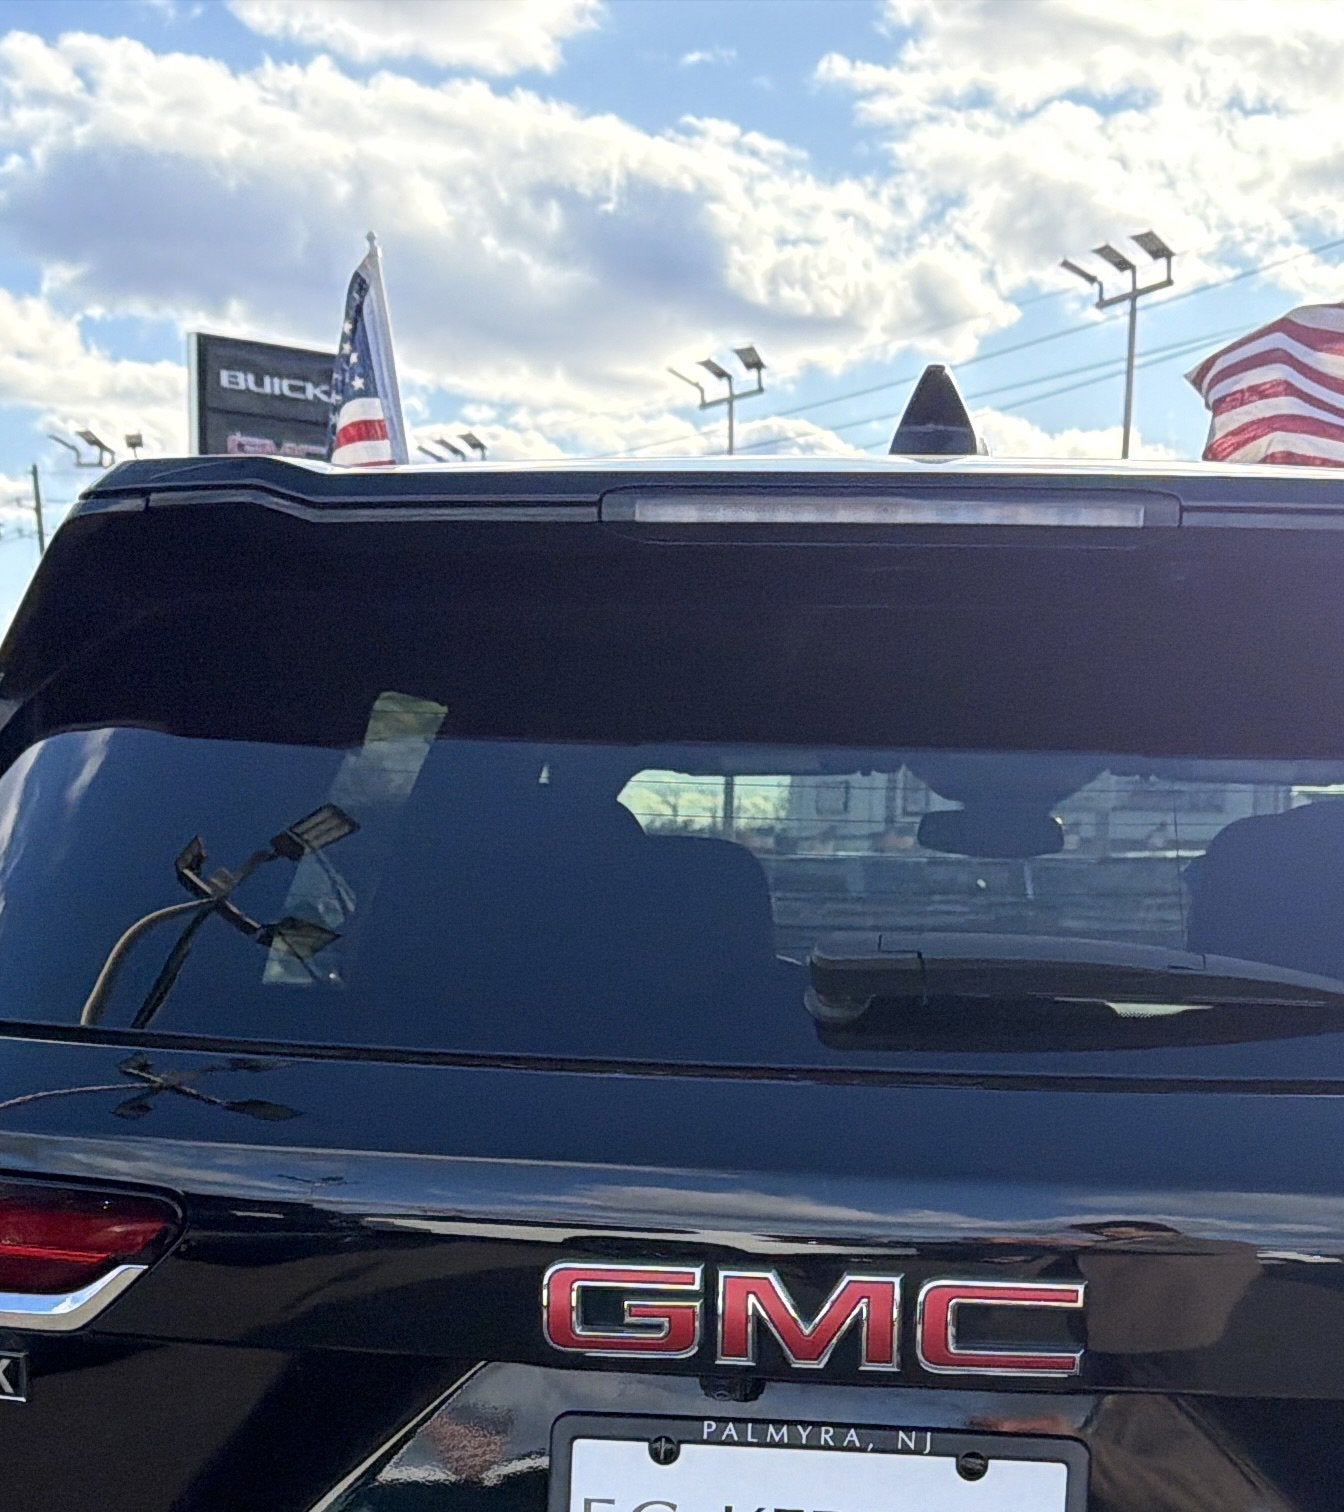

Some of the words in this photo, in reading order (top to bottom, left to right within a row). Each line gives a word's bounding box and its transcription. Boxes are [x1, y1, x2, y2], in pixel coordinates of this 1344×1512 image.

[220, 369, 335, 404] BUICK
[542, 1261, 1088, 1377] GMC
[702, 1420, 874, 1452] PALMYRA,
[897, 1430, 932, 1454] NJ
